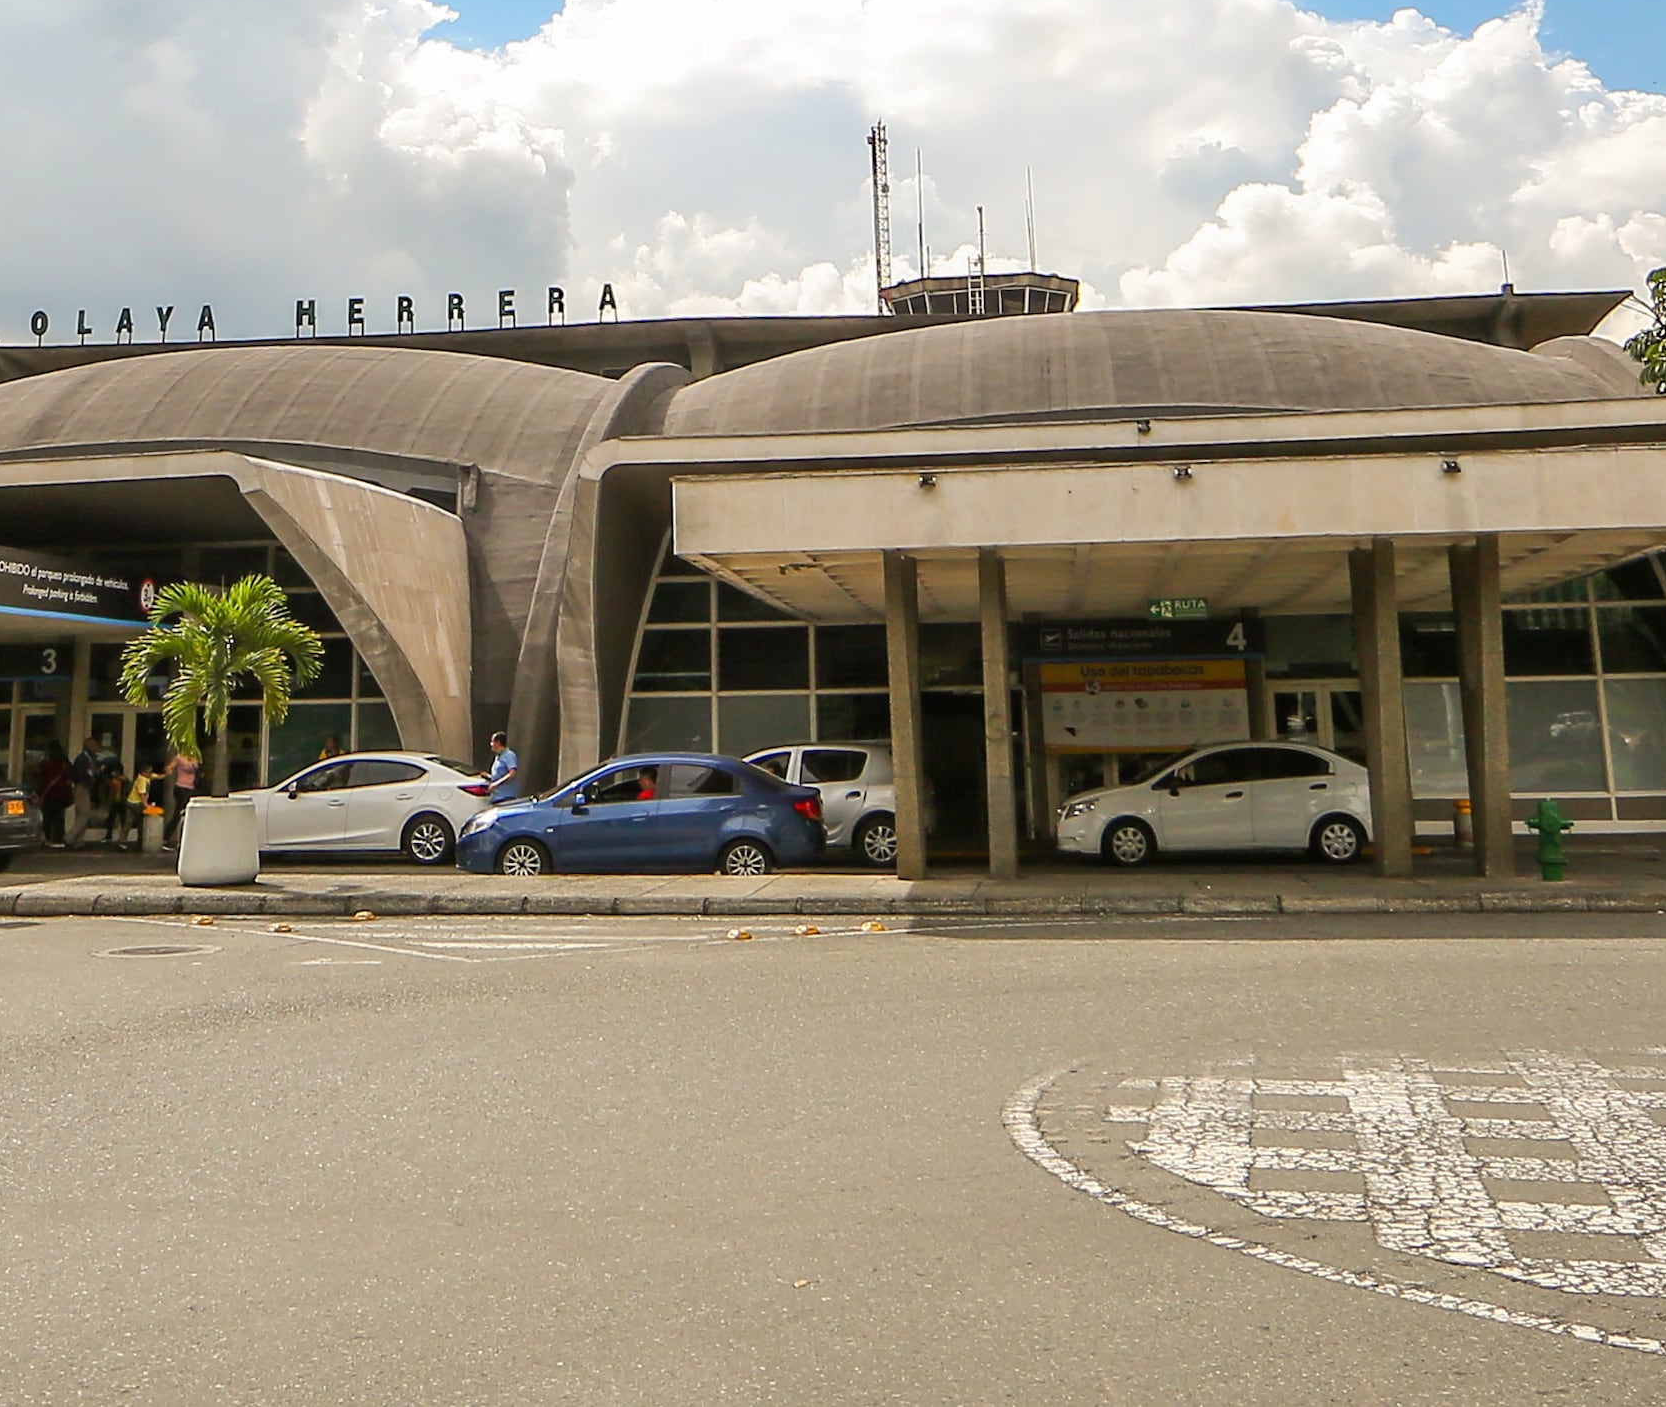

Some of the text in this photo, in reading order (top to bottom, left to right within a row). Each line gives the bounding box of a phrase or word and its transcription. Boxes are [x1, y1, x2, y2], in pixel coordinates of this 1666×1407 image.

[31, 305, 215, 336] OLAYA
[295, 284, 617, 326] HERRERA
[37, 568, 62, 582] parqueo
[1174, 600, 1206, 610] RUTA
[1067, 628, 1172, 640] Salidas nacionales
[1226, 622, 1248, 651] 4
[41, 649, 57, 674] 3
[1080, 663, 1205, 677] Uso del tapabocas
